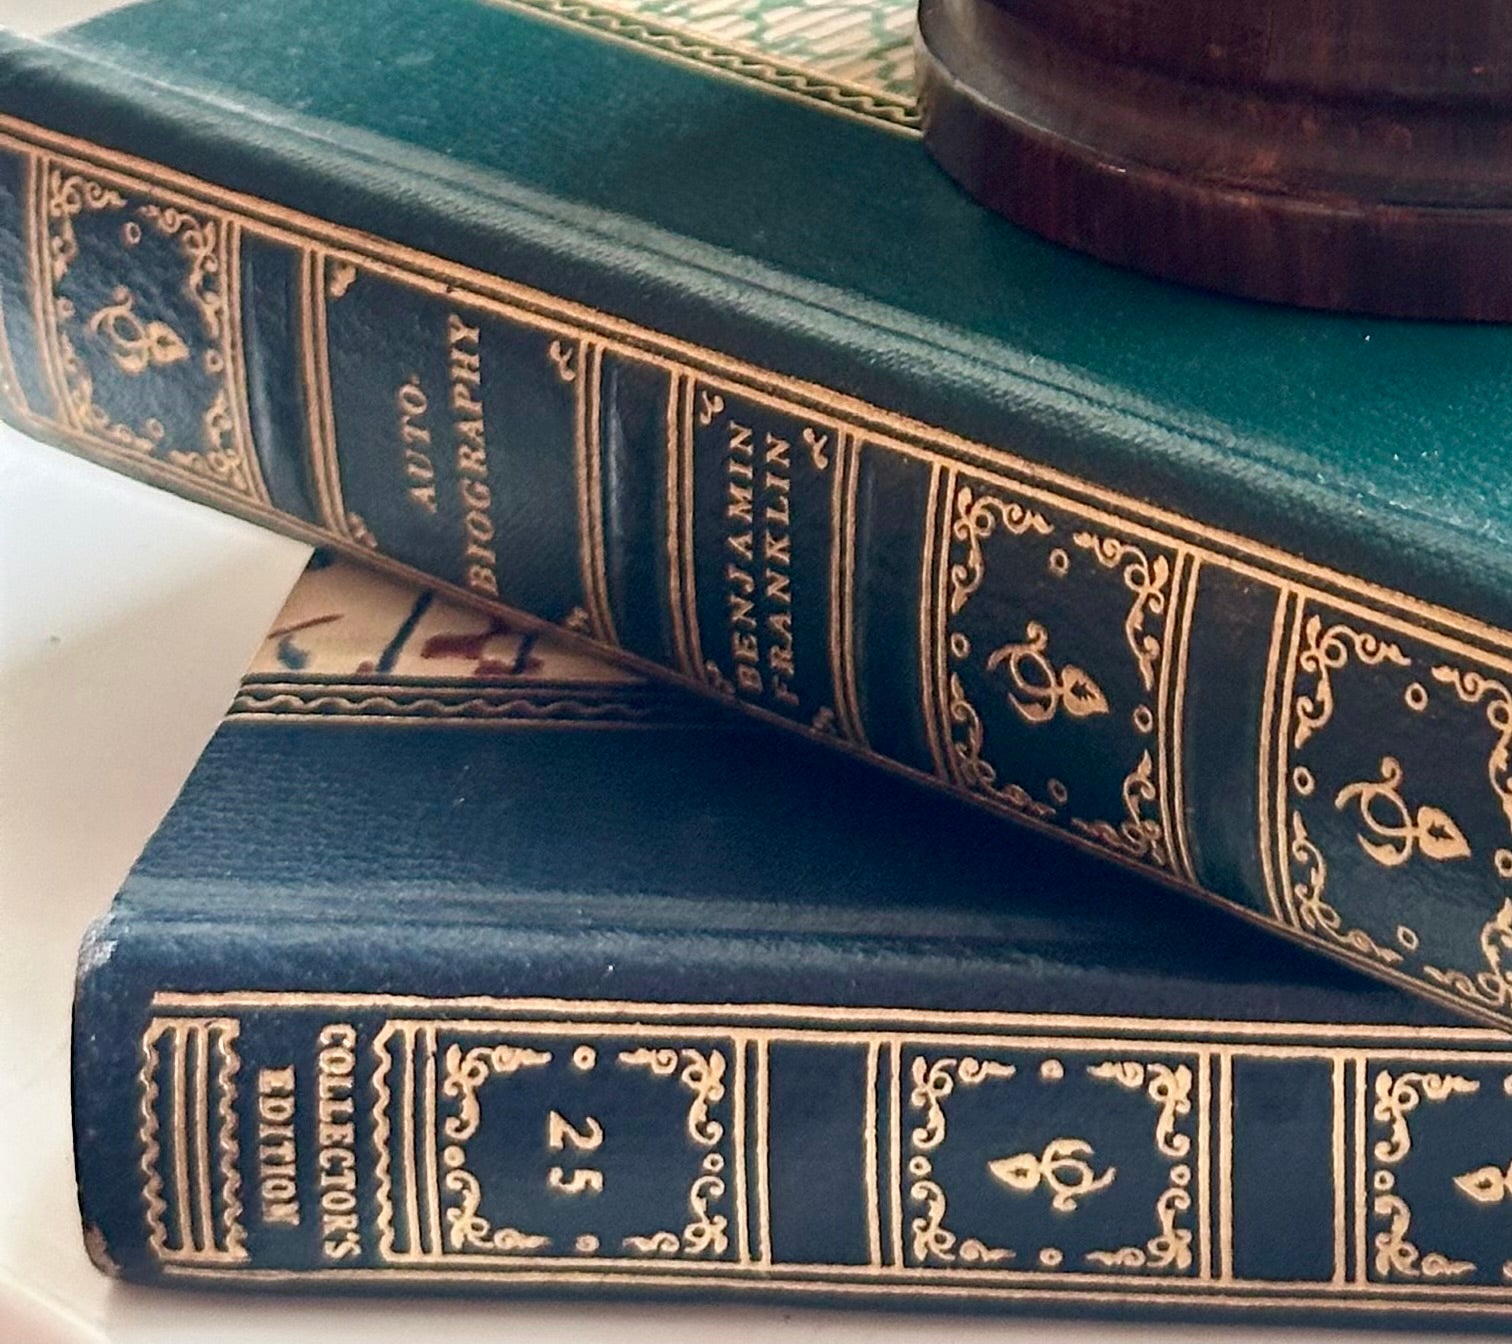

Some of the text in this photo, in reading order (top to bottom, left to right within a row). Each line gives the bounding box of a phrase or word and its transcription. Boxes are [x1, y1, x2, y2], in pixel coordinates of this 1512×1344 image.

[449, 314, 498, 596] BIOGRAPHY
[728, 420, 764, 697] BENJAMIN
[765, 433, 800, 705] FRANKLIN
[258, 1067, 300, 1224] EDITION
[319, 1024, 360, 1259] COLLECTOR'S
[549, 1111, 604, 1193] 25
